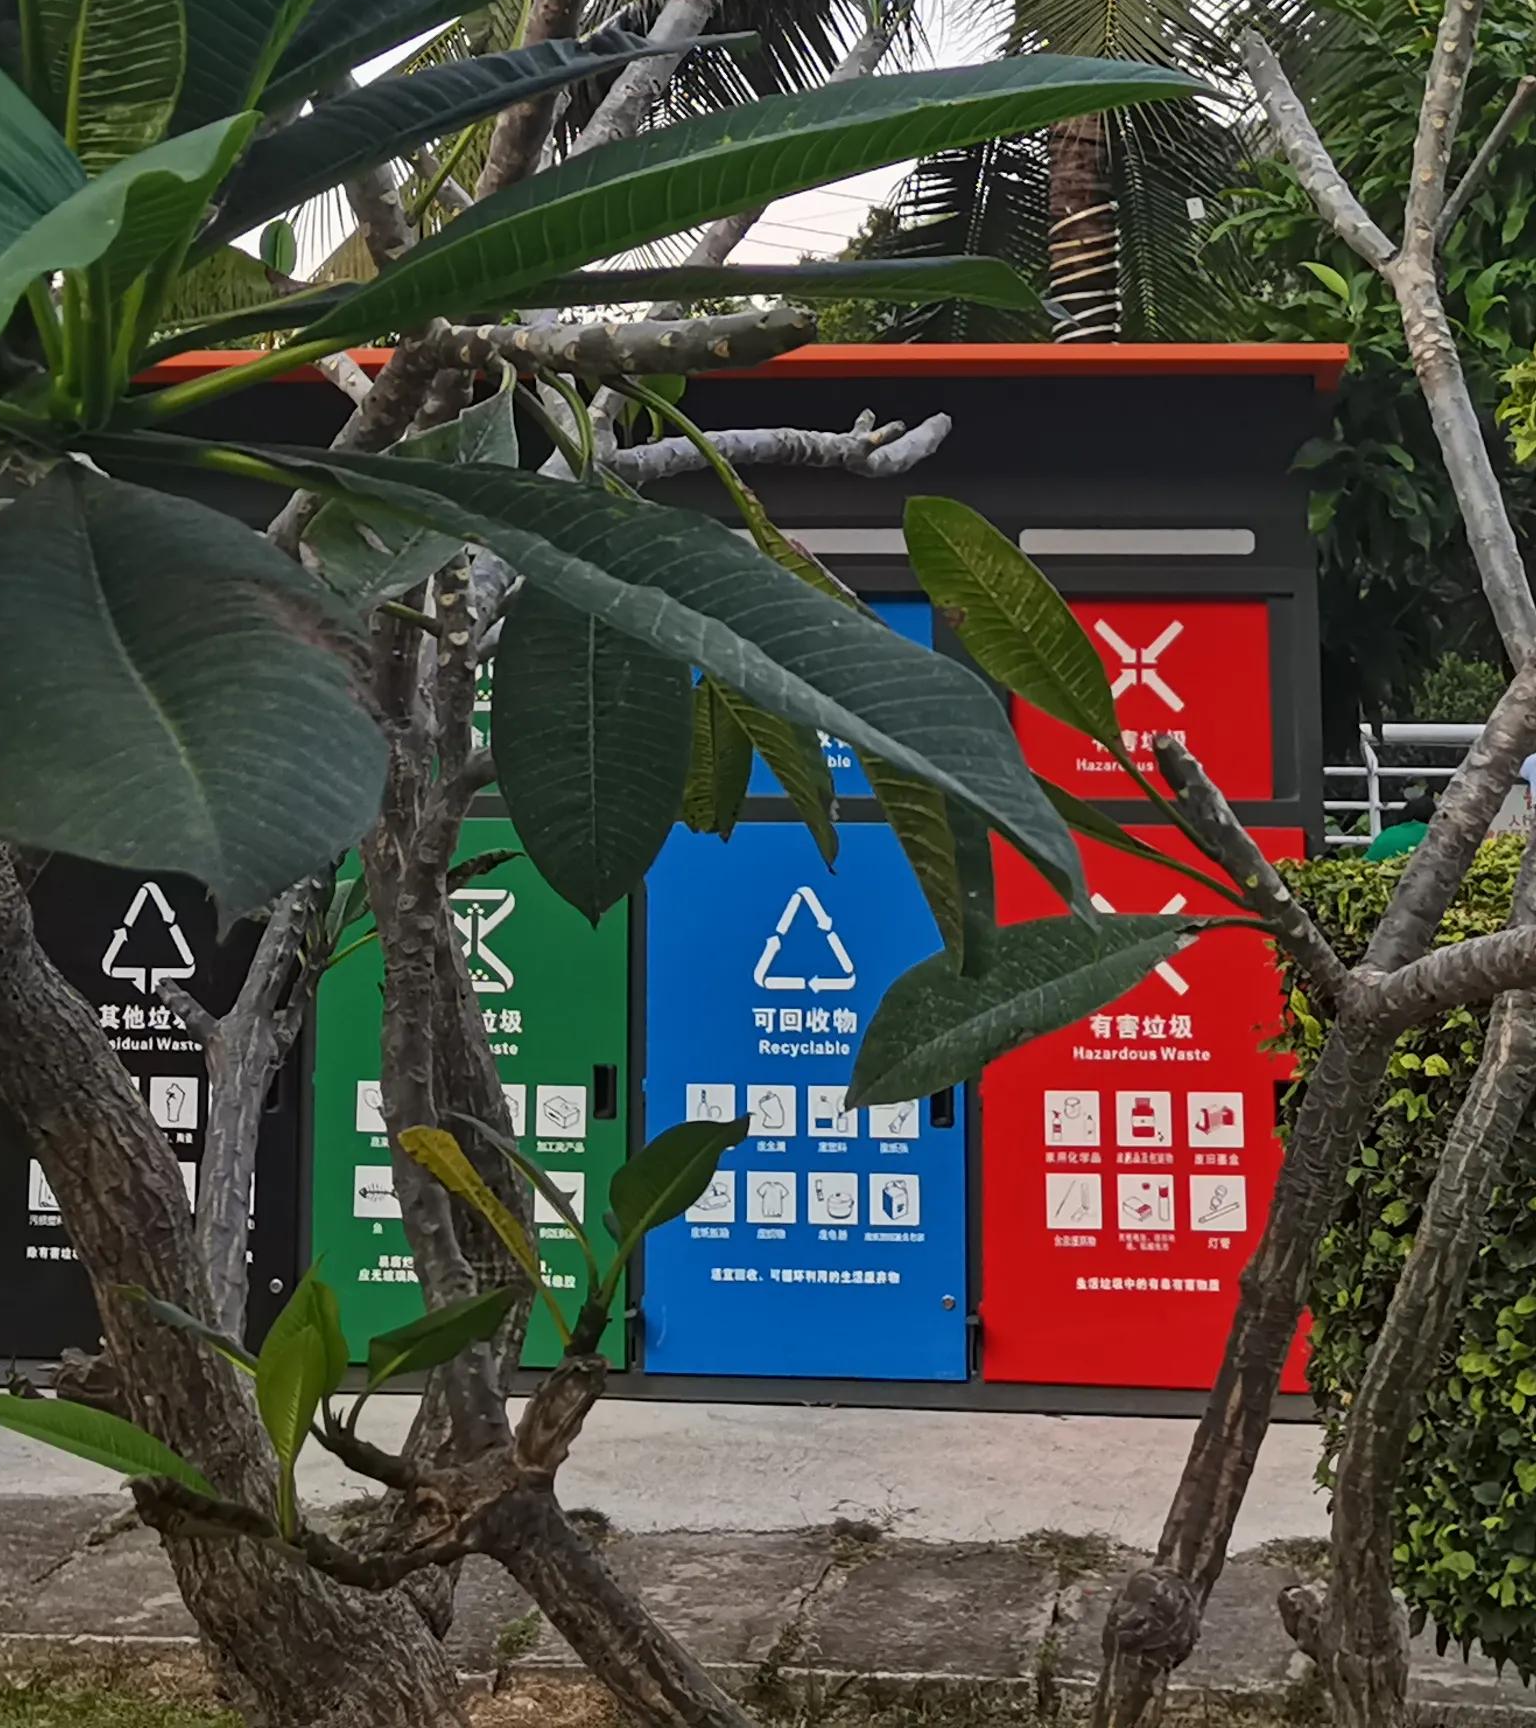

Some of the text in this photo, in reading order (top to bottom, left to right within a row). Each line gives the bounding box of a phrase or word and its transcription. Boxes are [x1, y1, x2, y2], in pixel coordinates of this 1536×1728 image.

[752, 1007, 858, 1034] 可回收物
[1089, 1013, 1193, 1039] 有害垃圾
[759, 1039, 850, 1058] Recyclable
[1072, 1046, 1211, 1061] Hazardous Waste
